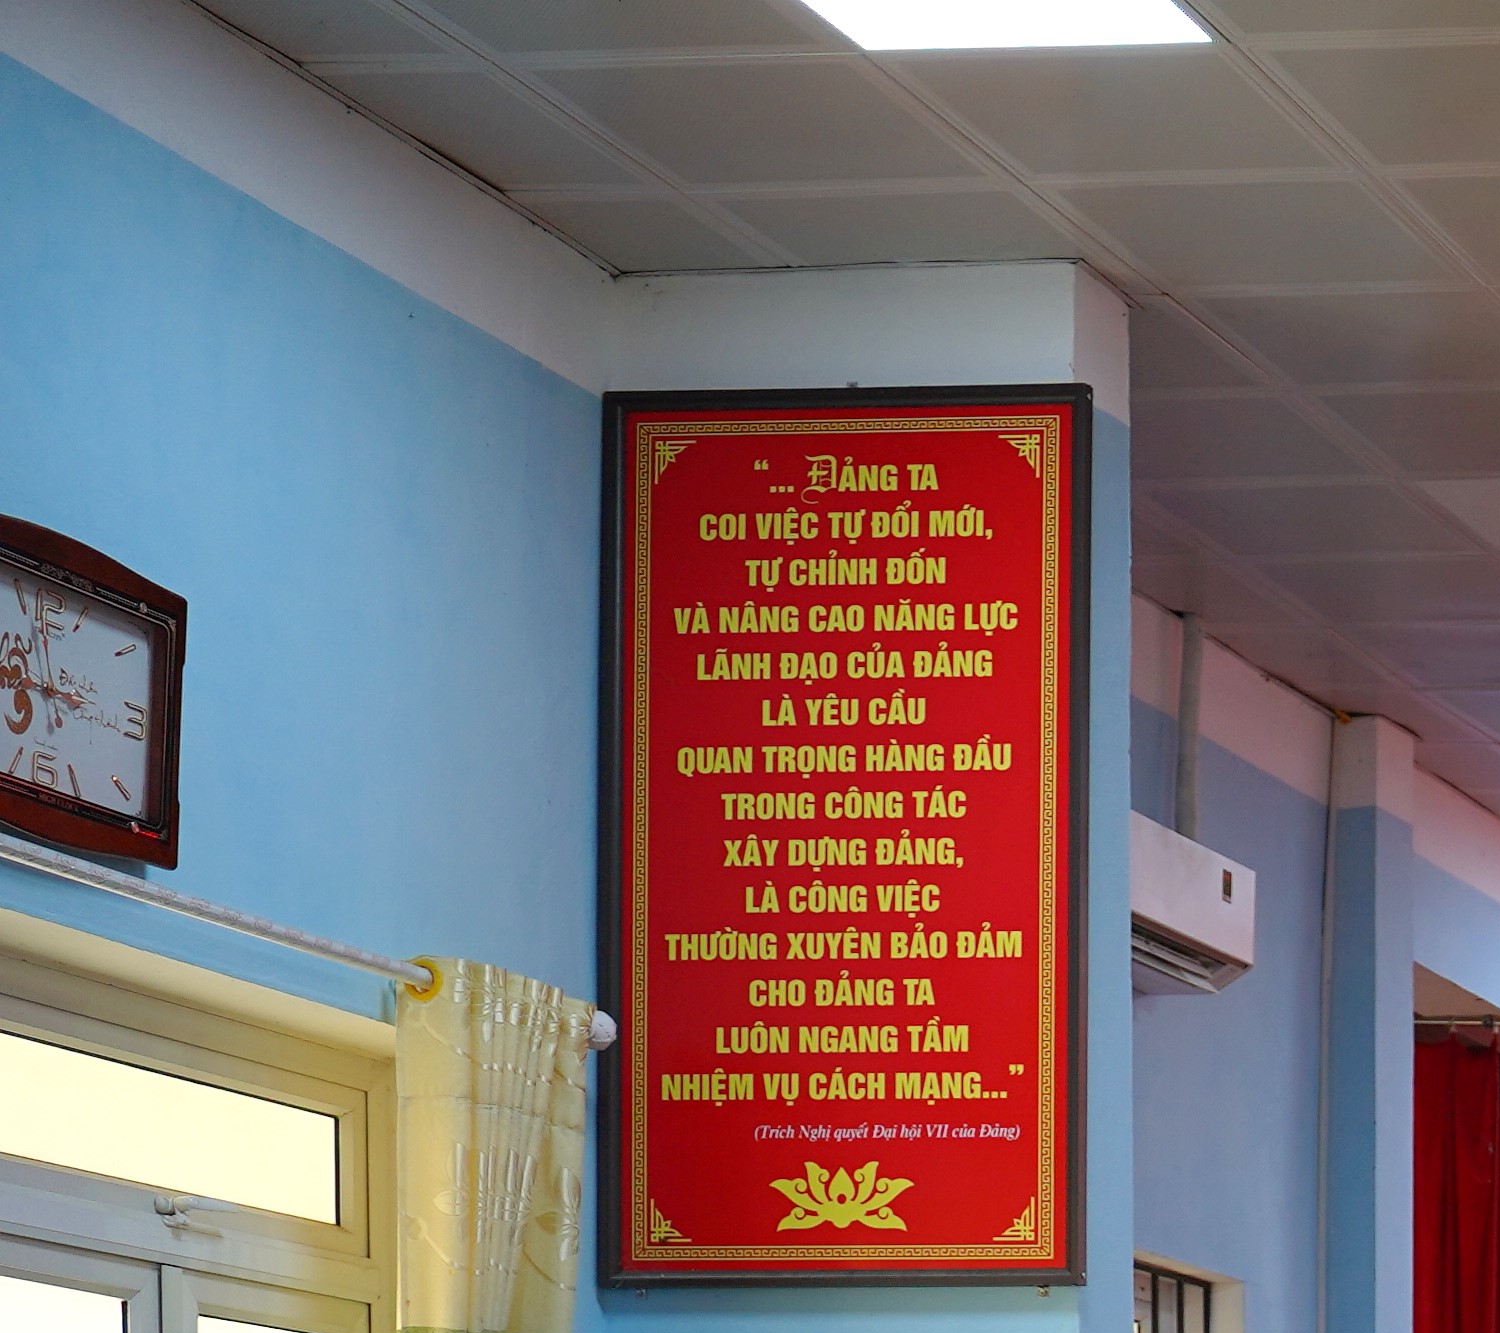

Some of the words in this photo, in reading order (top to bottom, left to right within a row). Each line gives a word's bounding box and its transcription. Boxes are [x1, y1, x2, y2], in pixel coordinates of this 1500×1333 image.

[801, 455, 898, 502] ĐẢNG
[907, 464, 938, 490] TA
[700, 514, 745, 540] COI
[756, 507, 819, 544] VIỆC
[828, 509, 866, 544] TỰ
[871, 500, 919, 537] ĐỔI
[929, 504, 992, 539] MỚI,
[745, 557, 784, 591] TỰ
[788, 550, 878, 587] CHỈNH
[886, 548, 946, 584] ĐỐN
[674, 602, 710, 634] VÀ
[720, 601, 799, 634] NÂNG
[809, 605, 864, 632] CAO
[874, 599, 954, 631] NĂNG
[965, 601, 1017, 636] LỰC
[124, 700, 147, 740] 3
[665, 927, 777, 960] THƯỜNG
[787, 927, 880, 959] XUYÊN
[891, 923, 947, 958] BẢO
[956, 922, 1022, 958] ĐẢM
[749, 979, 805, 1006] CHO
[815, 970, 894, 1006] ĐẢNG
[903, 979, 935, 1005] TA
[716, 1021, 789, 1053] LUÔN
[799, 1026, 898, 1053] NGANG
[907, 1016, 968, 1052] TẦM
[662, 1068, 753, 1105] NHIỆM
[763, 1073, 799, 1105] VỤ
[809, 1067, 885, 1100] CÁCH
[754, 1124, 794, 1142] (Trích
[799, 1124, 831, 1141] Nghị
[834, 1122, 868, 1142] quyết
[873, 1124, 897, 1140] Đại
[900, 1124, 922, 1141] hội
[926, 1124, 949, 1138] VII
[952, 1123, 975, 1138] của
[979, 1123, 1021, 1141] Đảng)
